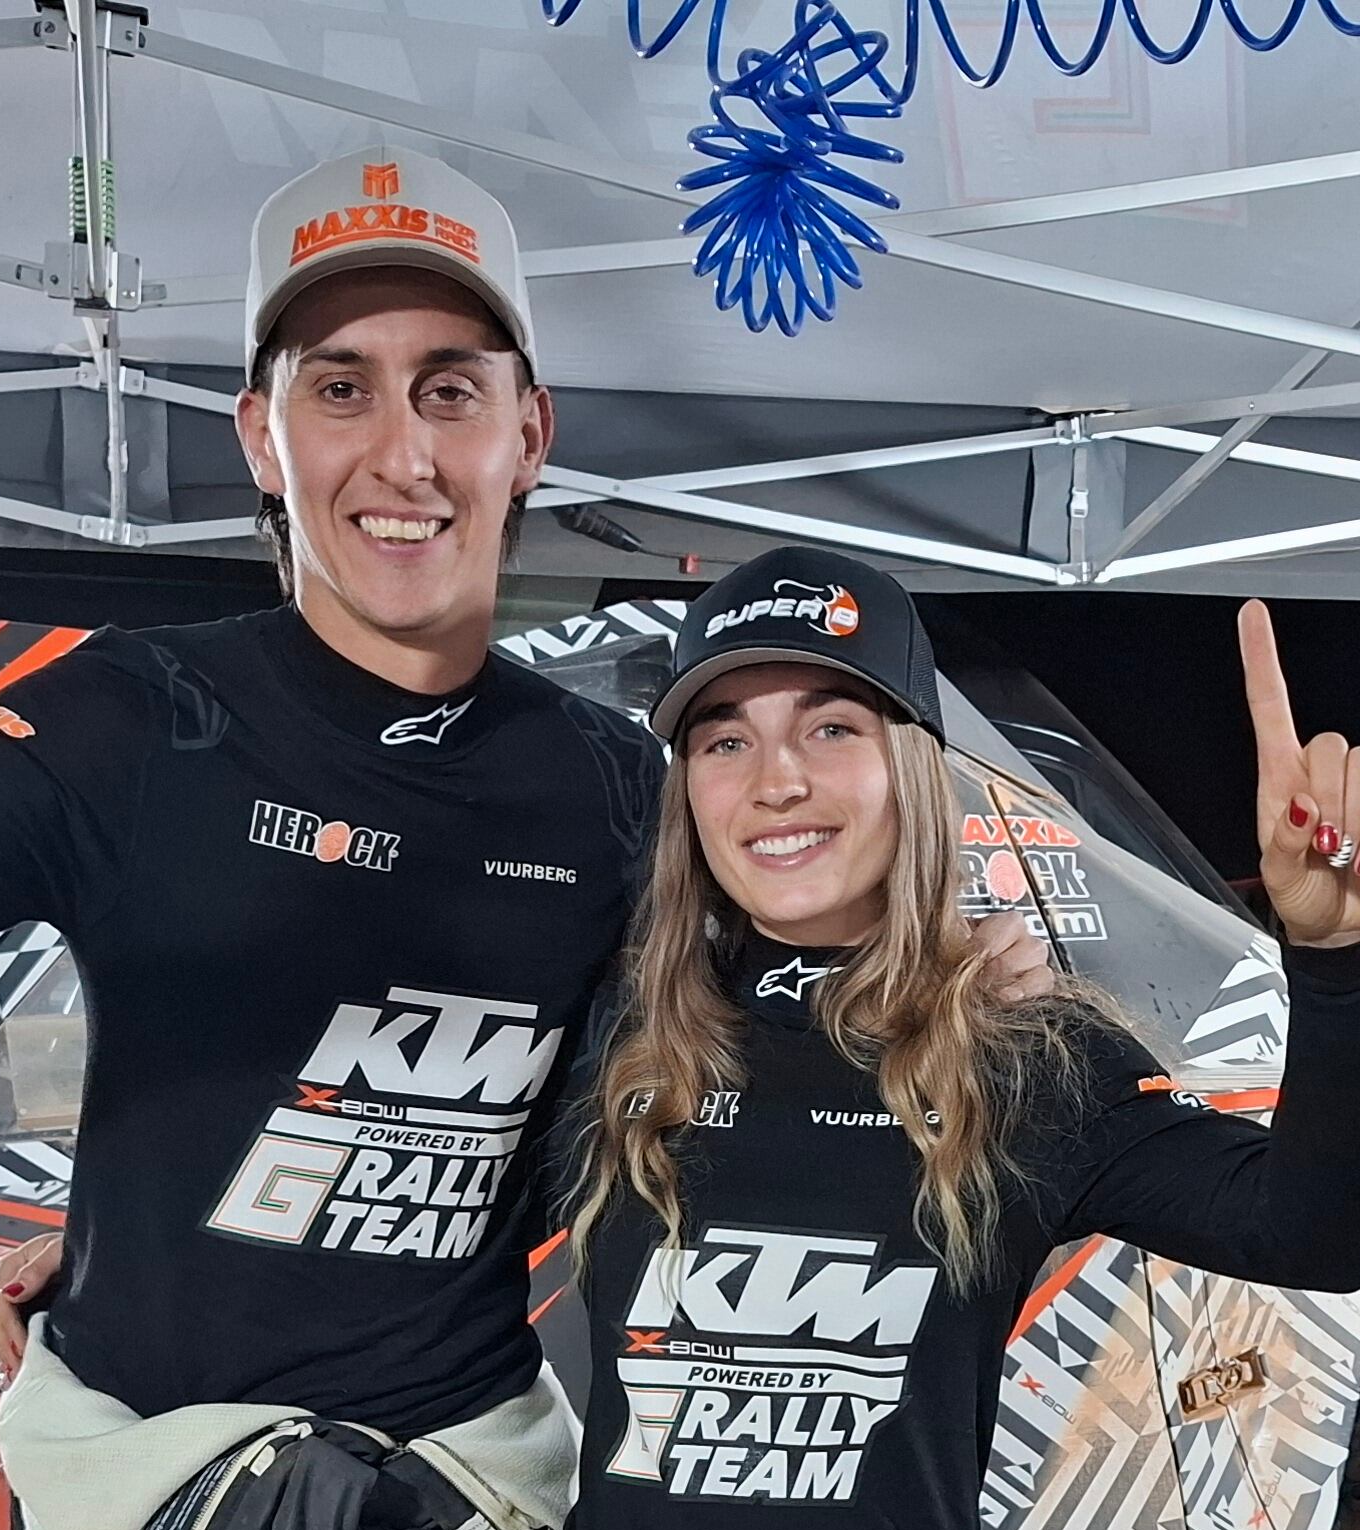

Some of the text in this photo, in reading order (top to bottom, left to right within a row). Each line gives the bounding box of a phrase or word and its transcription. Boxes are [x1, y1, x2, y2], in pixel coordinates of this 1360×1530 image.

[292, 204, 429, 256] MAXXIS
[705, 598, 823, 638] SUPER
[249, 800, 401, 871] HEROCK
[484, 860, 577, 883] VUURBERG
[297, 987, 565, 1104] KTM
[294, 1084, 407, 1122] X-BOW
[354, 1127, 486, 1152] POWERED BY
[336, 1149, 512, 1207] RALLY
[321, 1200, 491, 1258] TEAM
[625, 1228, 938, 1345] KTM
[625, 1330, 733, 1360] X-BOW
[688, 1366, 832, 1389] POWERED BY
[677, 1390, 899, 1446] RALLY
[669, 1445, 863, 1500] TEAM
